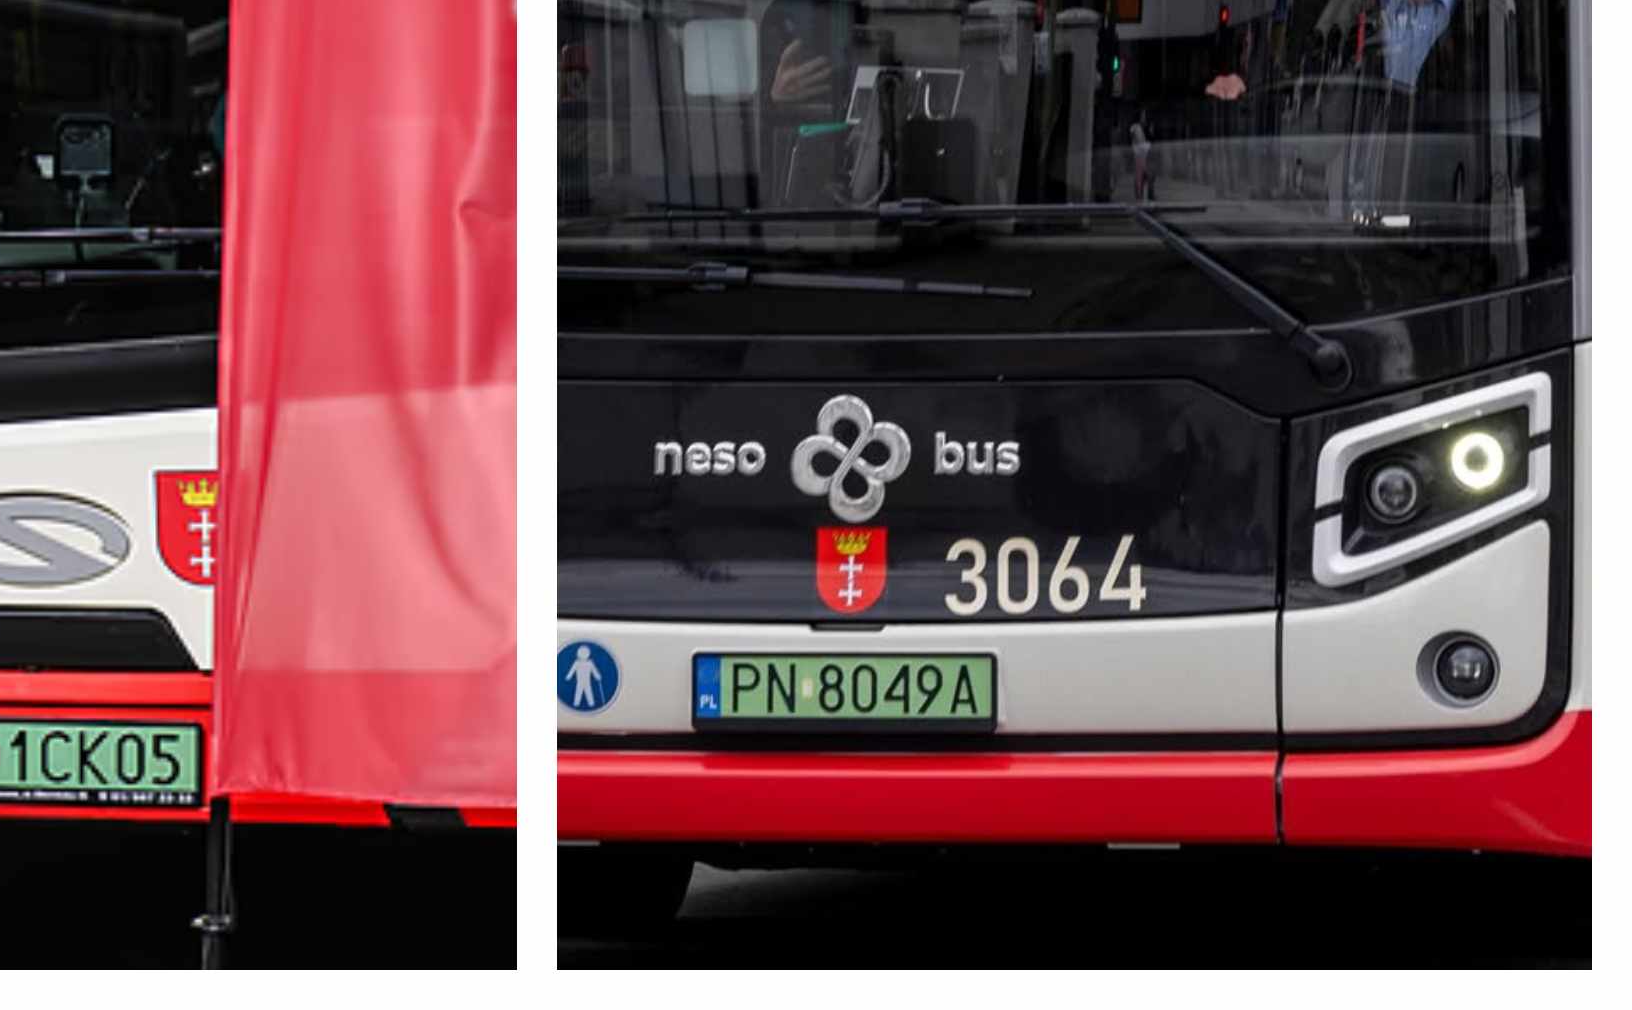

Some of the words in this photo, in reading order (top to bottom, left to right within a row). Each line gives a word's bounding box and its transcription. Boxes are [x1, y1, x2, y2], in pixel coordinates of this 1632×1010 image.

[653, 439, 767, 476] neso
[933, 431, 1022, 476] bus
[944, 534, 1147, 615] 3064
[699, 694, 718, 710] PL
[730, 662, 798, 714] PN
[818, 662, 979, 715] 8049A
[9, 730, 181, 785] 1CK05
